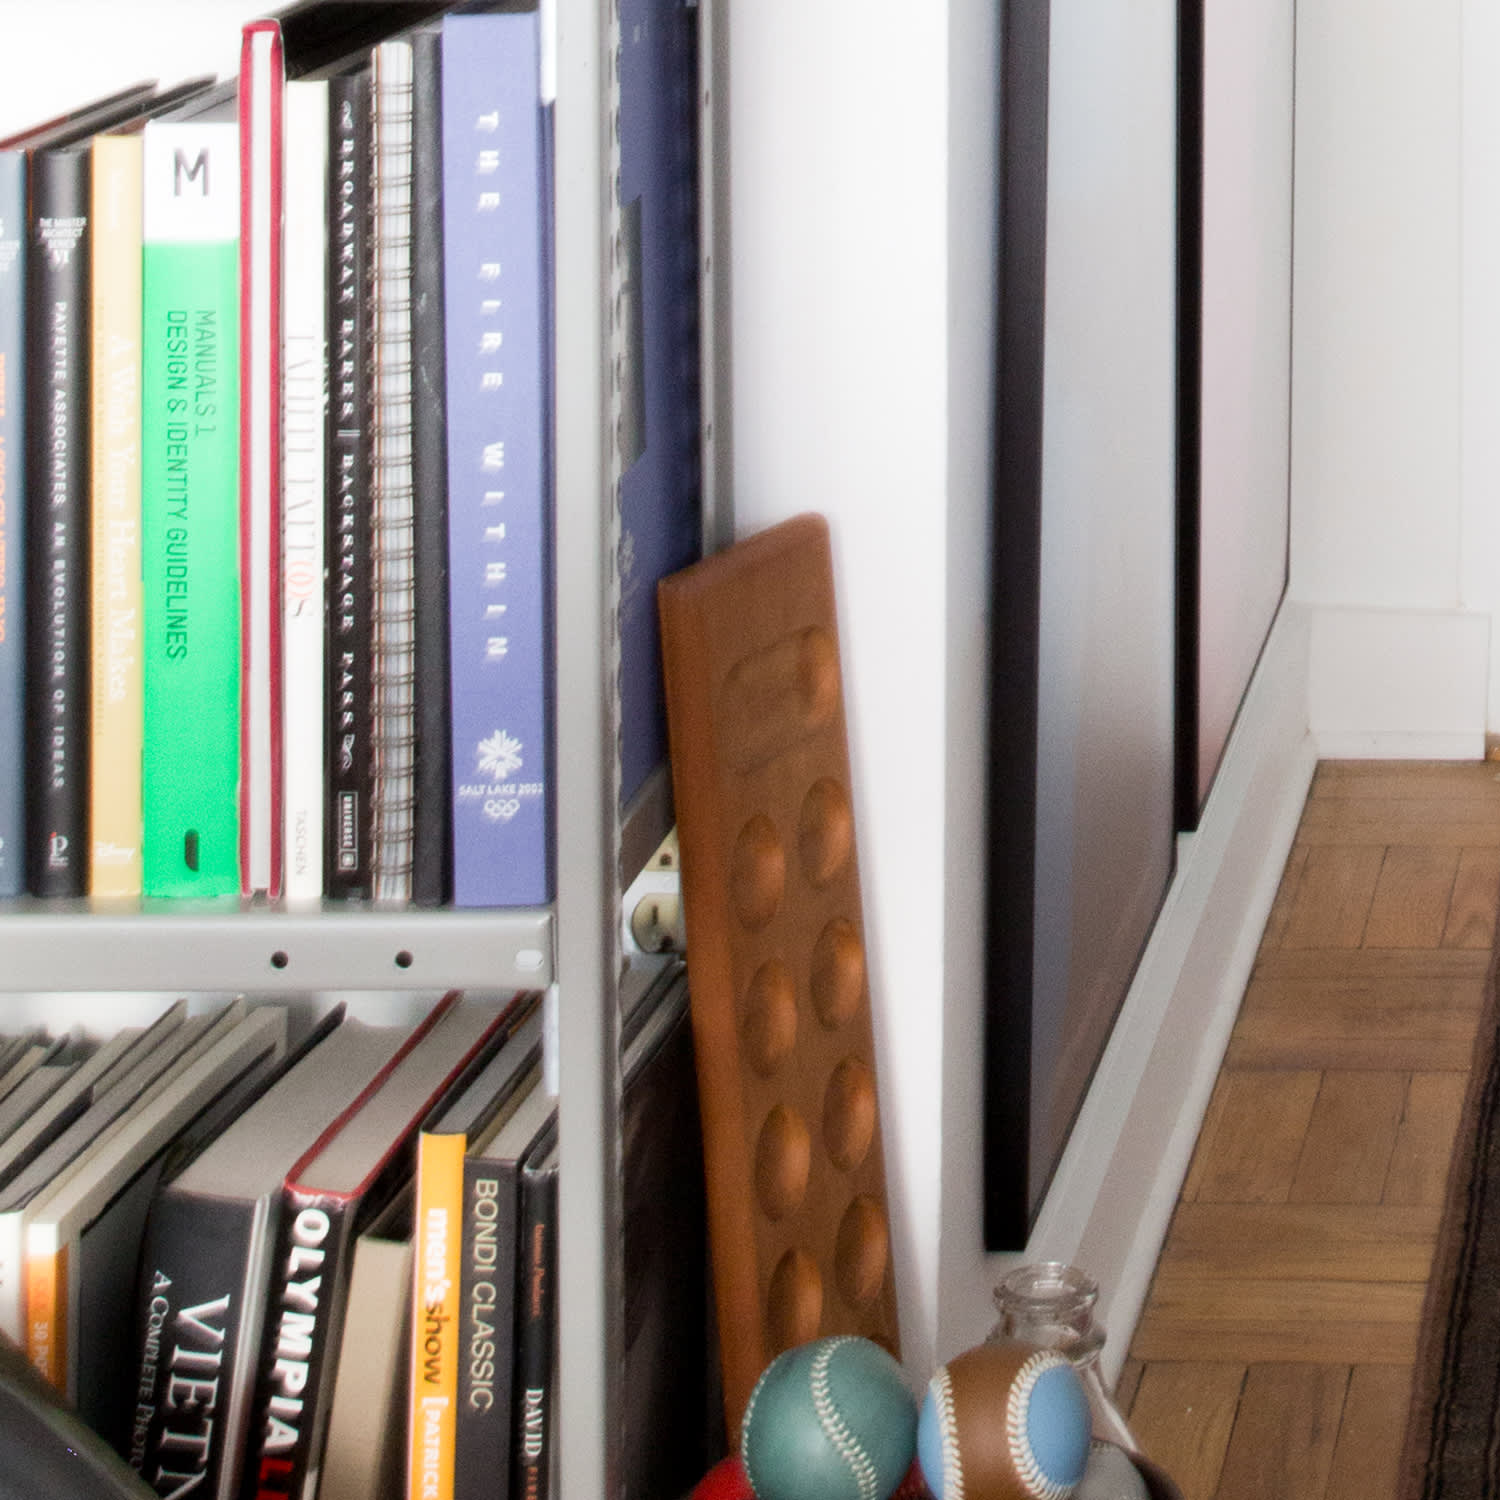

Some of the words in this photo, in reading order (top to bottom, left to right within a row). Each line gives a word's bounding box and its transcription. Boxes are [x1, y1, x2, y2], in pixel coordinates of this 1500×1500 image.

[174, 147, 210, 197] M
[478, 110, 501, 212] THE
[340, 138, 355, 303] BROADWAY
[54, 301, 67, 381] PAYETTE
[166, 310, 189, 390] DESIGN
[194, 309, 217, 418] MANUALS
[340, 319, 355, 421] BARES
[481, 262, 504, 391] FIRE
[54, 388, 67, 505] ASSOCIATES
[166, 398, 188, 414] &
[194, 423, 217, 440] 1
[166, 421, 189, 521] IDENTITY
[53, 521, 66, 547] AN
[110, 519, 137, 600] Heart
[340, 453, 355, 632] BACKSTAGE
[481, 441, 509, 659] WITHIN
[53, 559, 66, 678] EVOLUTION
[165, 527, 189, 661] GUIDELINES
[52, 688, 65, 713] OF
[110, 607, 137, 704] Makes
[340, 651, 355, 728] PASS
[52, 725, 65, 788] IDEAS
[295, 808, 309, 877] TASCHEN
[342, 795, 354, 849] UNIVERSE
[474, 1178, 499, 1272] BONDI
[153, 1269, 174, 1292] A
[137, 1295, 170, 1402] COMPLETE
[263, 1207, 331, 1454] OLYMPIA
[471, 1281, 497, 1414] CLASSIC
[525, 1387, 544, 1460] DAVID
